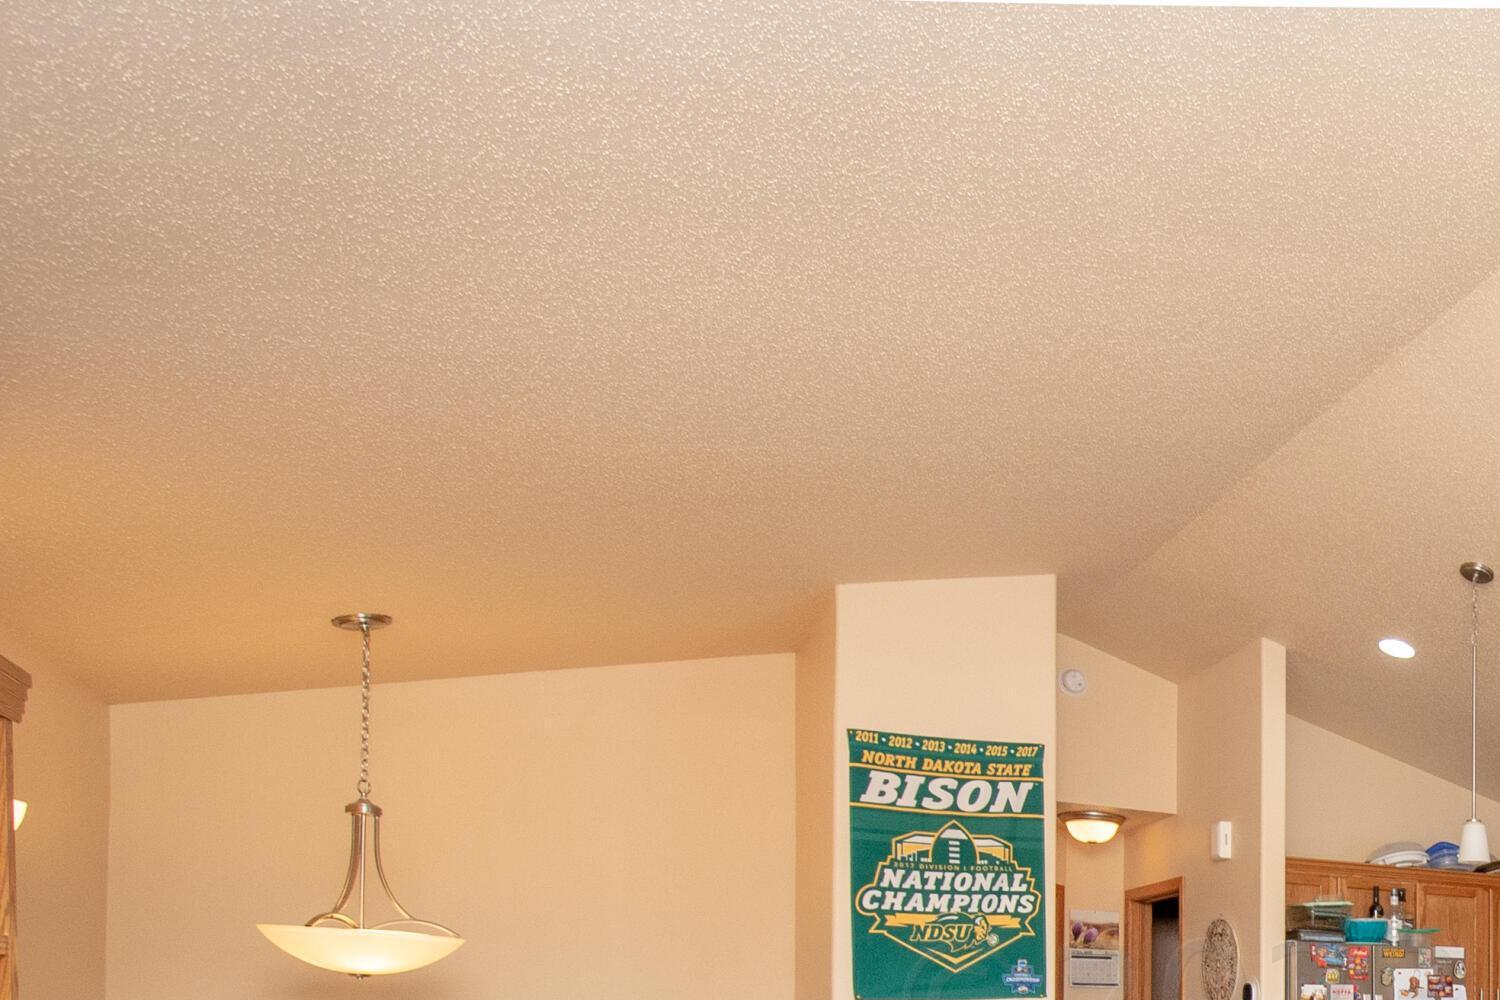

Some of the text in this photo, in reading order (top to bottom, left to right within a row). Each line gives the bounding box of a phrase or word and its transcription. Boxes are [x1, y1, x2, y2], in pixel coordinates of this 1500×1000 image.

[855, 730, 1038, 758] 2011 2012 2013 2014 2015 2017
[862, 749, 1033, 776] NORTH DAKOTA STATE
[859, 769, 1034, 812] BISON
[919, 863, 960, 871] DIVISION
[880, 868, 1028, 892] NATIONAL
[862, 889, 1036, 914] CHAMPIONS
[909, 923, 974, 943] NDSU
